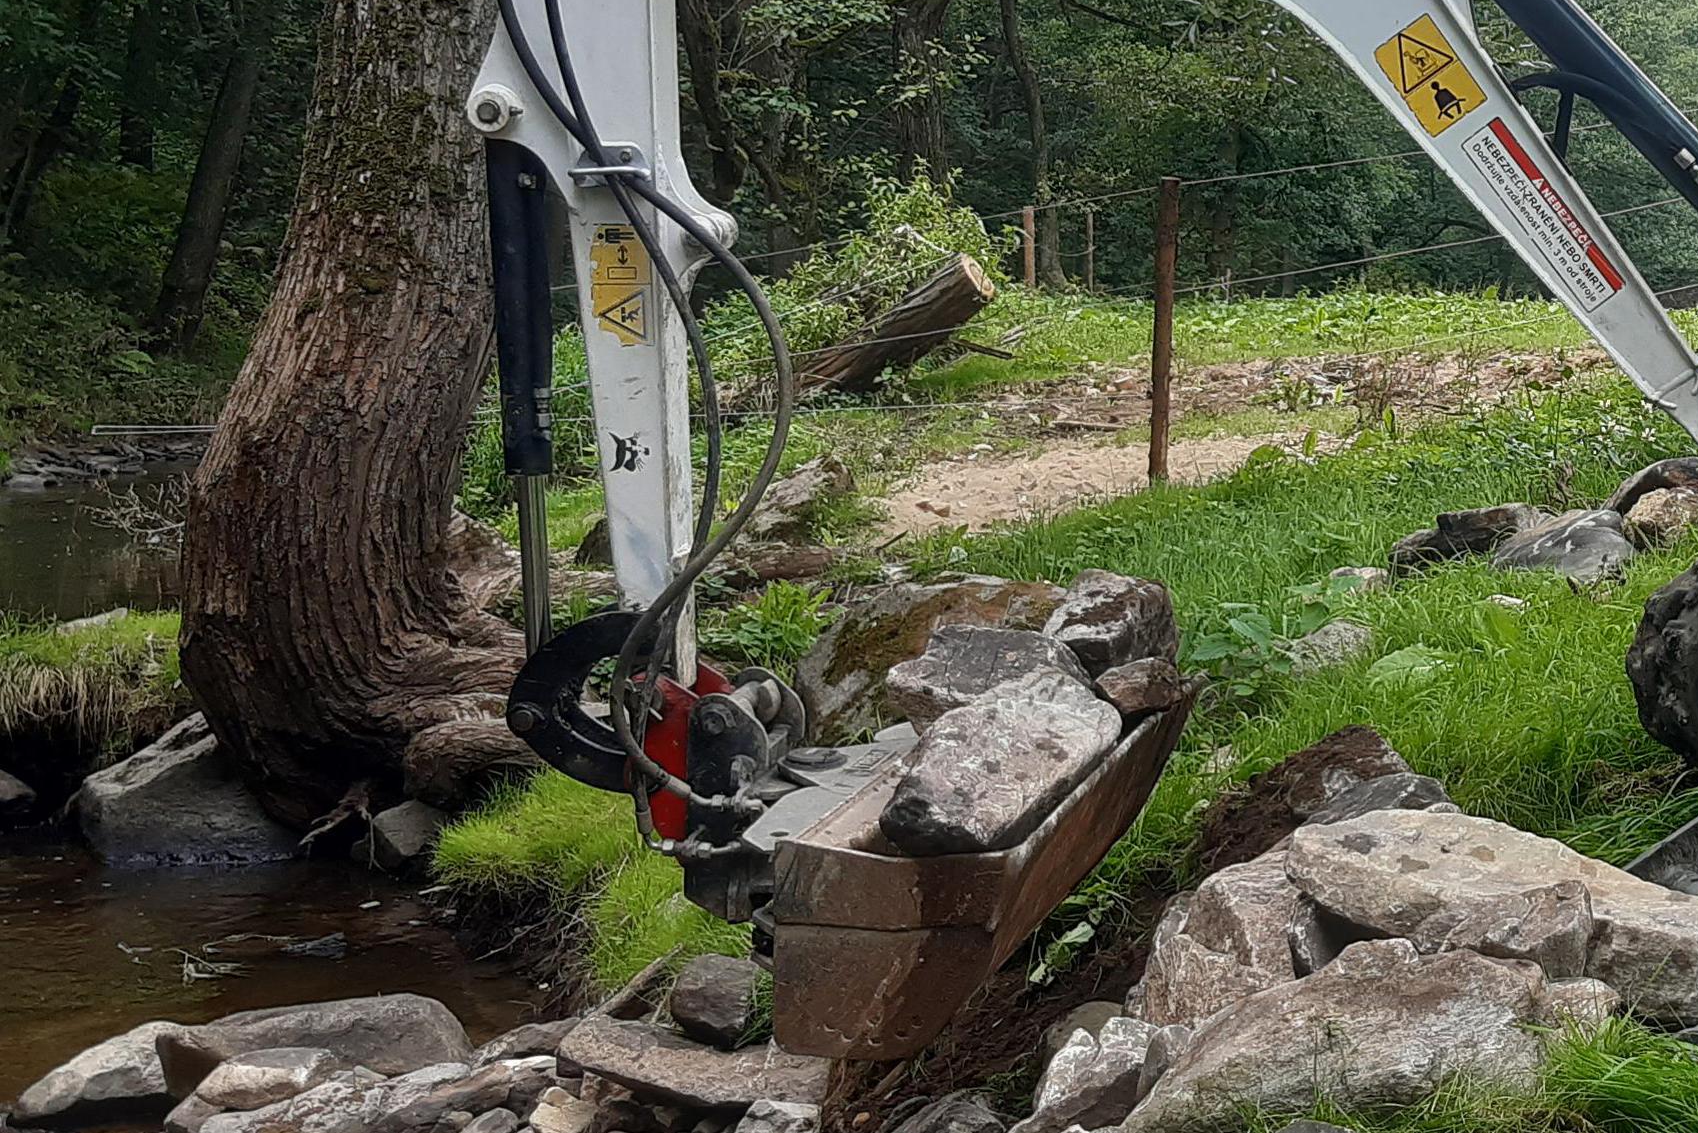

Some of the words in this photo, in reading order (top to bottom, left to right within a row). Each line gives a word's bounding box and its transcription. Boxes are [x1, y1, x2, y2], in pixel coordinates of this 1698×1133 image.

[1472, 143, 1504, 185] Dodržujte
[1538, 230, 1554, 250] min.
[1553, 248, 1561, 257] 3
[1559, 257, 1568, 266] m
[1567, 267, 1578, 279] od
[1576, 278, 1597, 302] stroje
[1482, 135, 1528, 193] NEBEZPEČÍ
[1524, 191, 1560, 235] ZRANĚNÍ
[1556, 234, 1581, 263] NEBO
[1579, 262, 1606, 293] SMRTI
[1541, 187, 1591, 249] NEBEZPEČÍ
